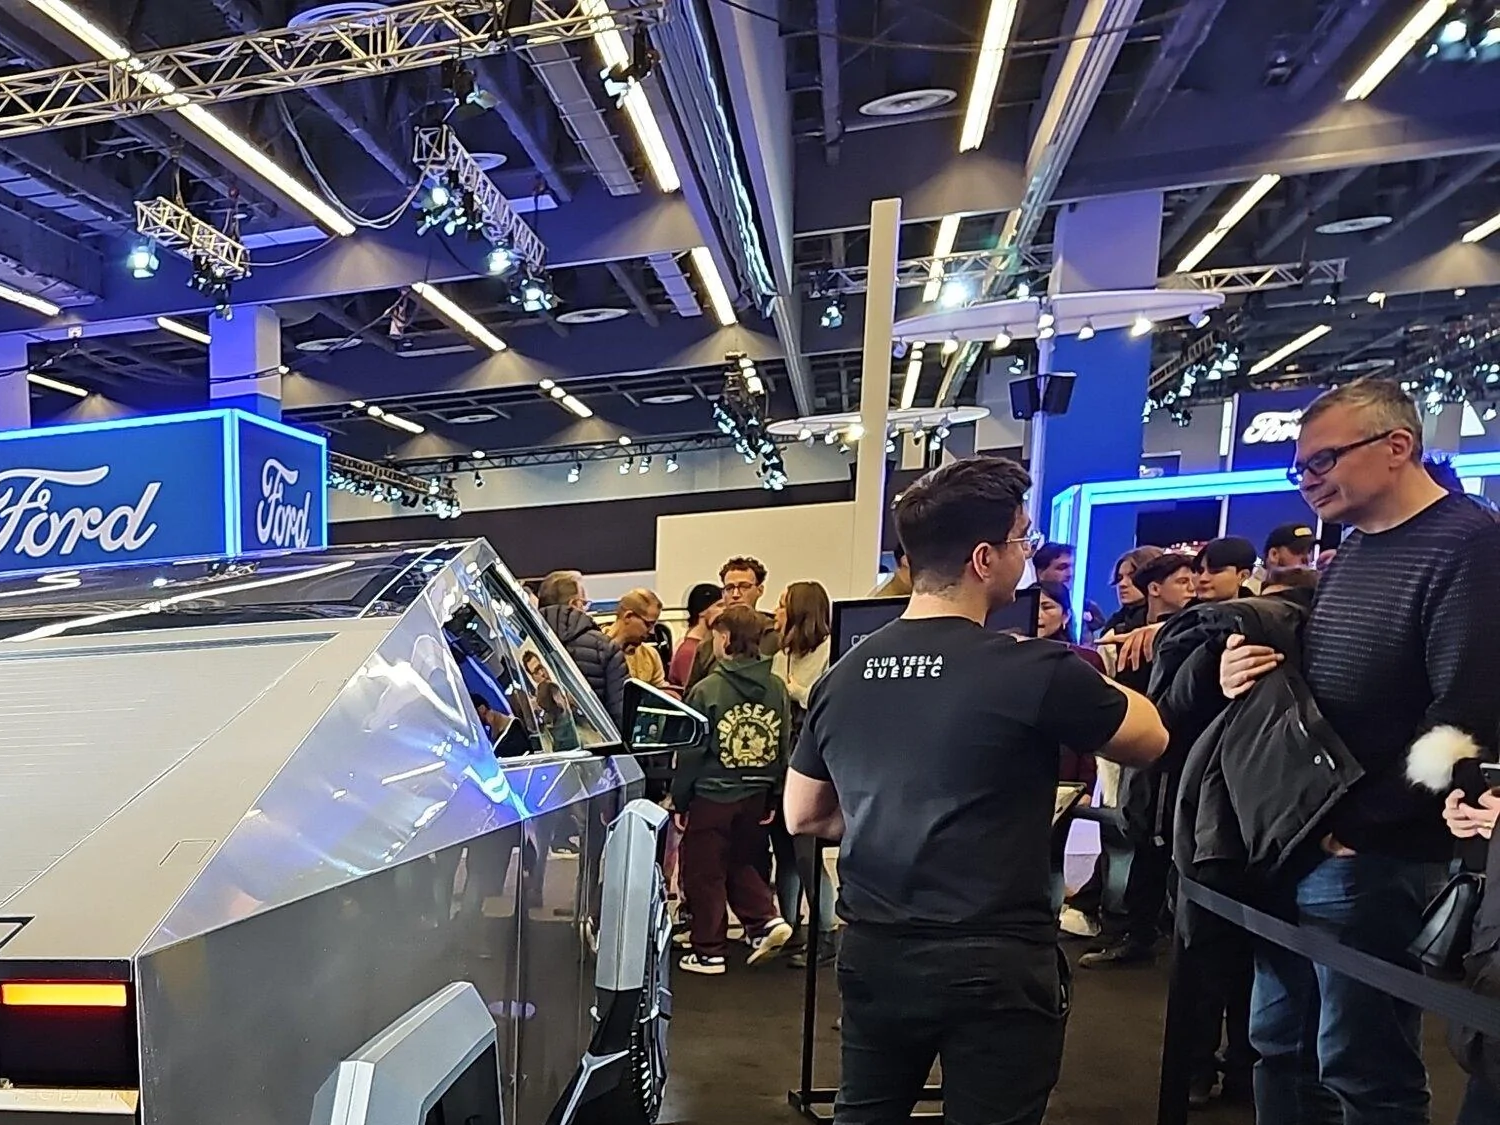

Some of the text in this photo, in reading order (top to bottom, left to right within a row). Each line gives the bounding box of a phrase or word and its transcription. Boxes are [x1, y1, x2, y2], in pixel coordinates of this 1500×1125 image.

[1242, 408, 1302, 445] For
[256, 458, 312, 548] Ford
[863, 665, 942, 679] QUÉBEC
[866, 655, 943, 668] CLUB TESLA
